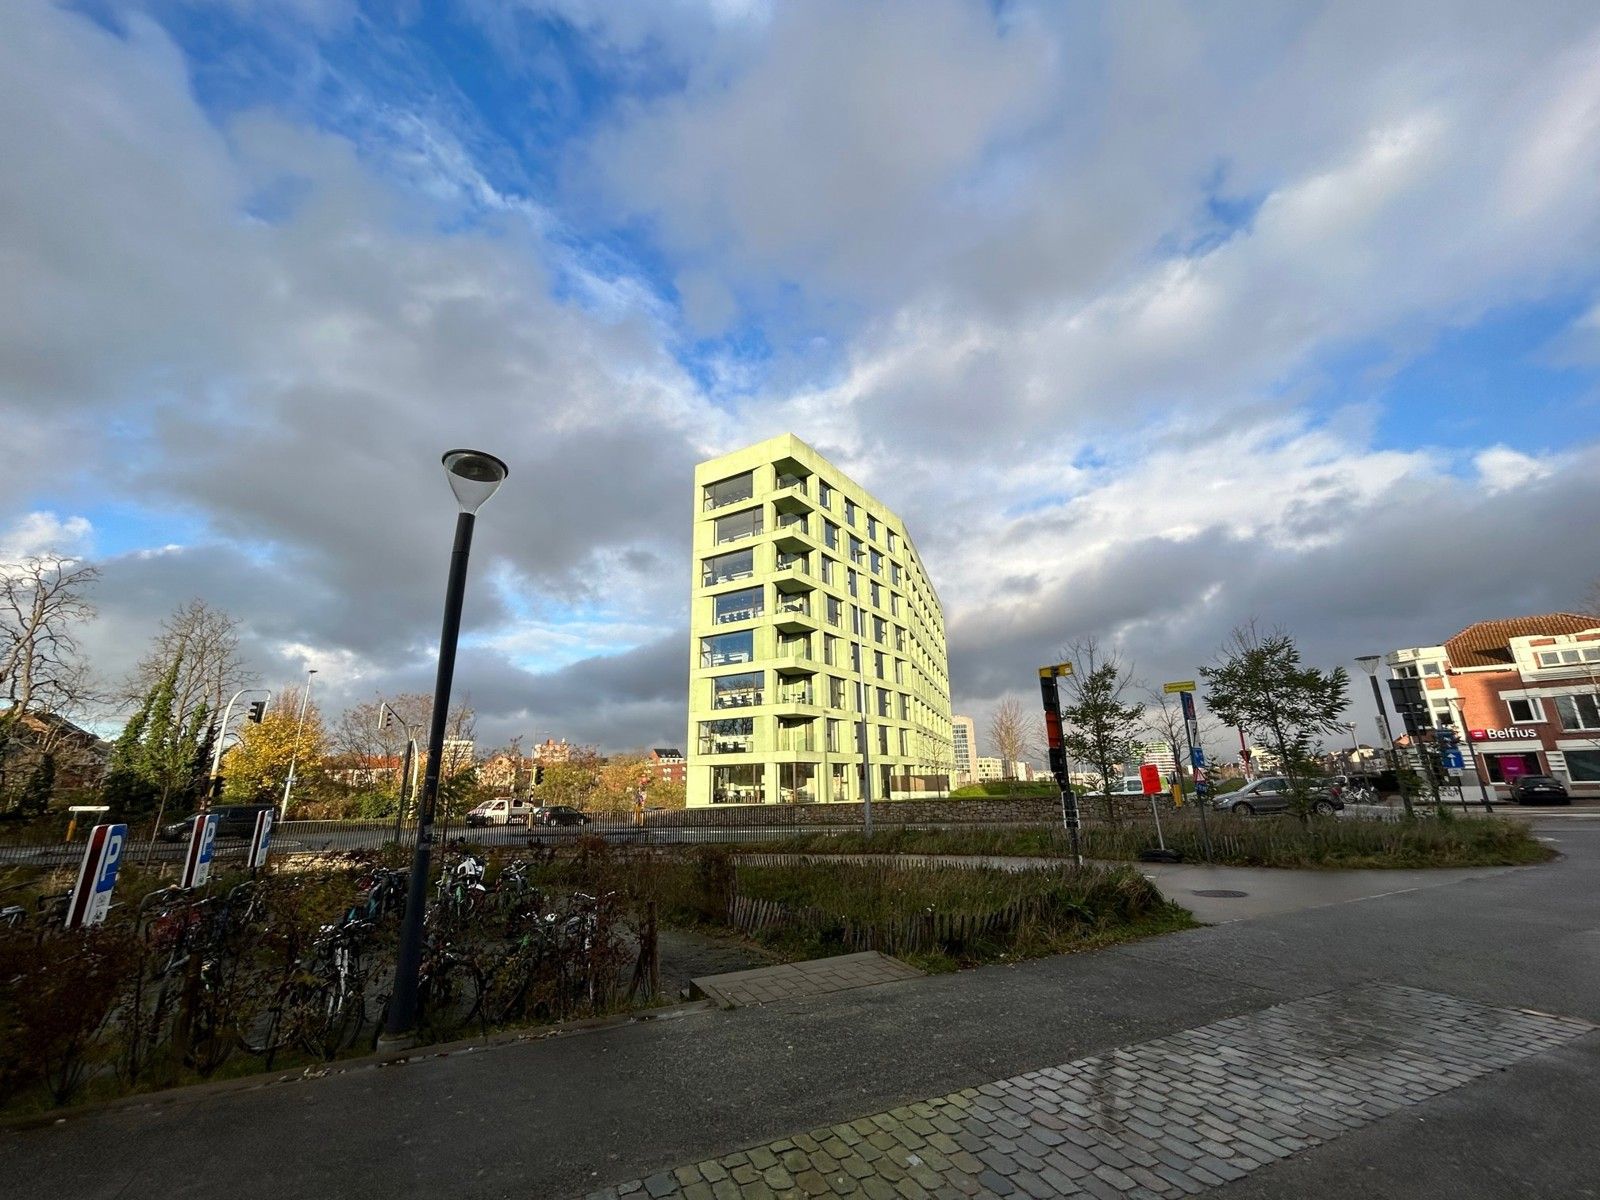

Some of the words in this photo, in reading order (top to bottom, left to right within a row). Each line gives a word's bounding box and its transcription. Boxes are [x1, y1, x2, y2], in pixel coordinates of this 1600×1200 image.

[1487, 728, 1537, 739] Belfius
[202, 822, 216, 855] P
[100, 834, 122, 882] P
